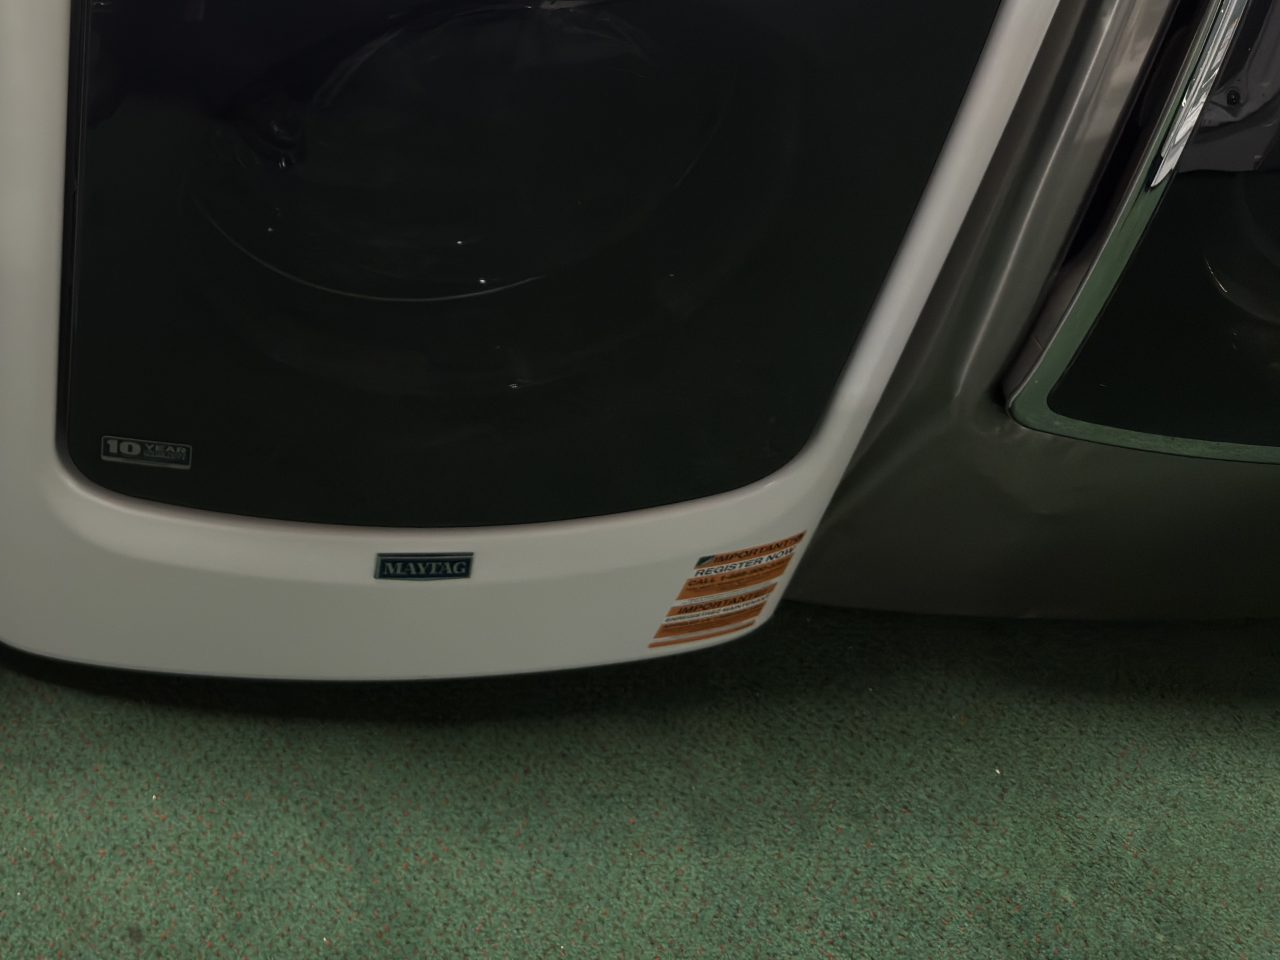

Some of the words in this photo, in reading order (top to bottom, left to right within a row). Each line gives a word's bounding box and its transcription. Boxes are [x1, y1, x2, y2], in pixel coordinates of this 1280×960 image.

[107, 439, 142, 456] 10
[384, 561, 467, 575] MAYTAG
[695, 557, 763, 577] REGISTER
[765, 547, 796, 562] NOW
